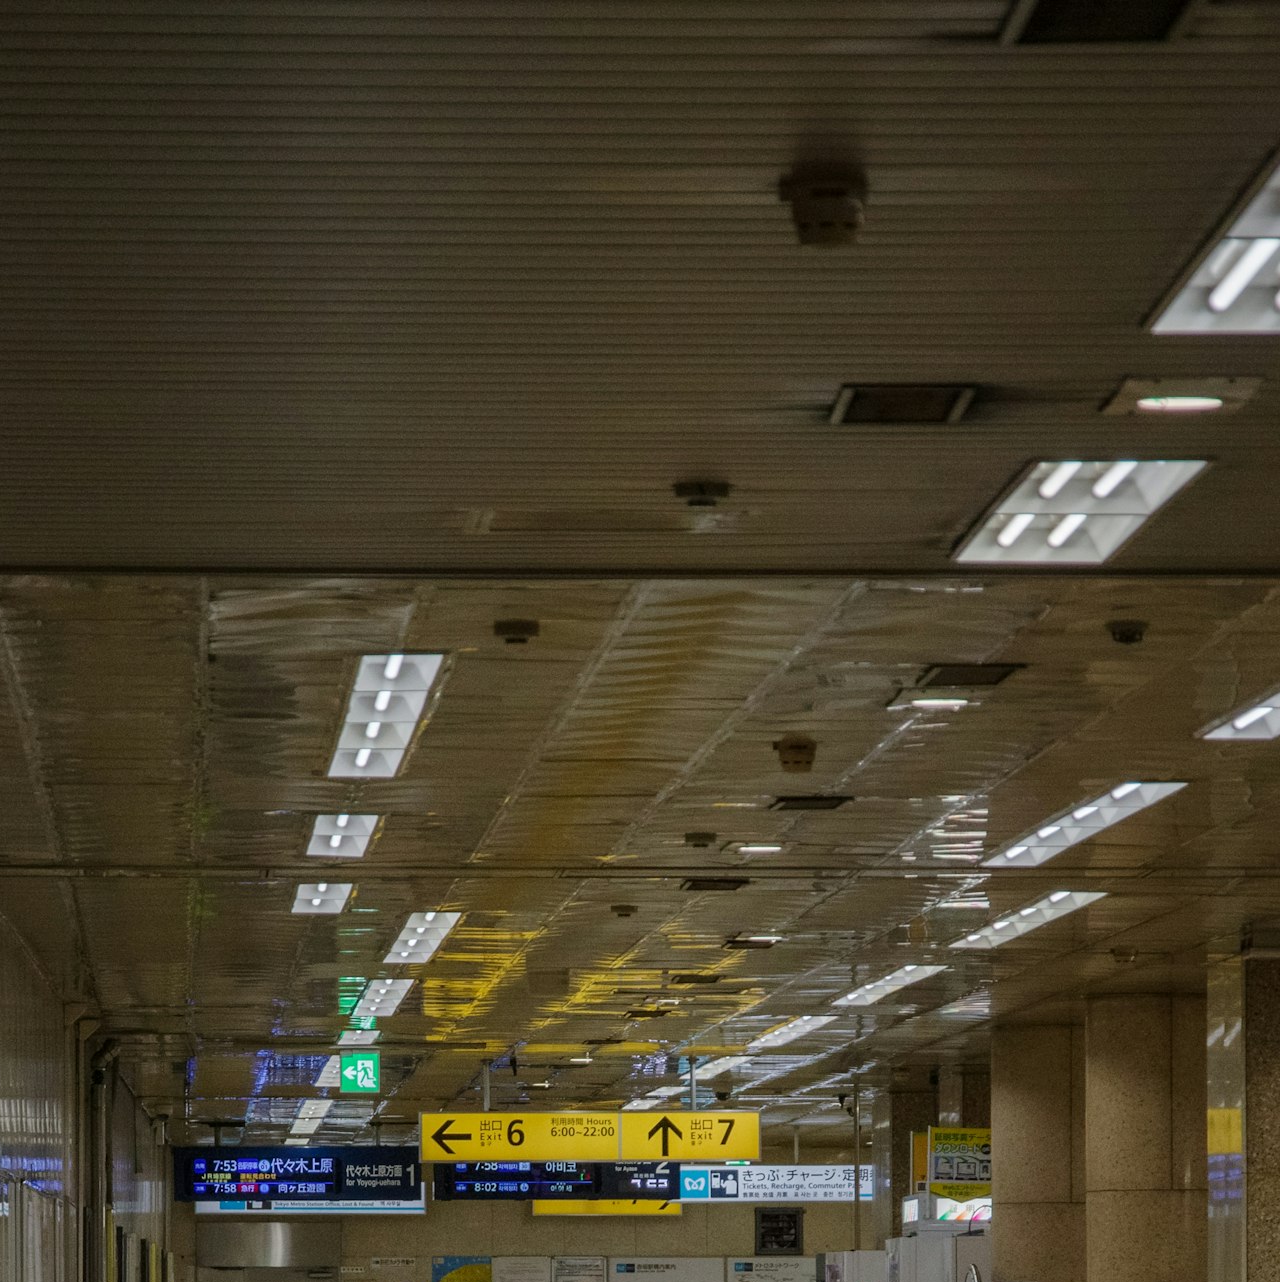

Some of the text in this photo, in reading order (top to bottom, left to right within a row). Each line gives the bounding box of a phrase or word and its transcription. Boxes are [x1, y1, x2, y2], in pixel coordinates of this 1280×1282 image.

[480, 1120, 502, 1131] 出口
[551, 1118, 584, 1126] 利用時間
[690, 1119, 713, 1130] 出口
[480, 1133, 502, 1141] Exit
[507, 1120, 525, 1146] 6
[551, 1127, 615, 1137] 6:00~22:00
[690, 1132, 713, 1141] Exit
[718, 1119, 735, 1145] 7
[936, 1143, 979, 1154] ダウンロード
[213, 1160, 237, 1171] 7:53
[270, 1158, 333, 1173] 代々木上原
[545, 1162, 576, 1173] 아비코
[345, 1164, 415, 1186] 代々木上原方面 1
[346, 1178, 401, 1188] for Yoyogi-uehara
[474, 1183, 497, 1192] 8:02
[771, 1183, 806, 1191] Recharge,
[214, 1184, 237, 1193] 7:58
[240, 1184, 255, 1193] 急行
